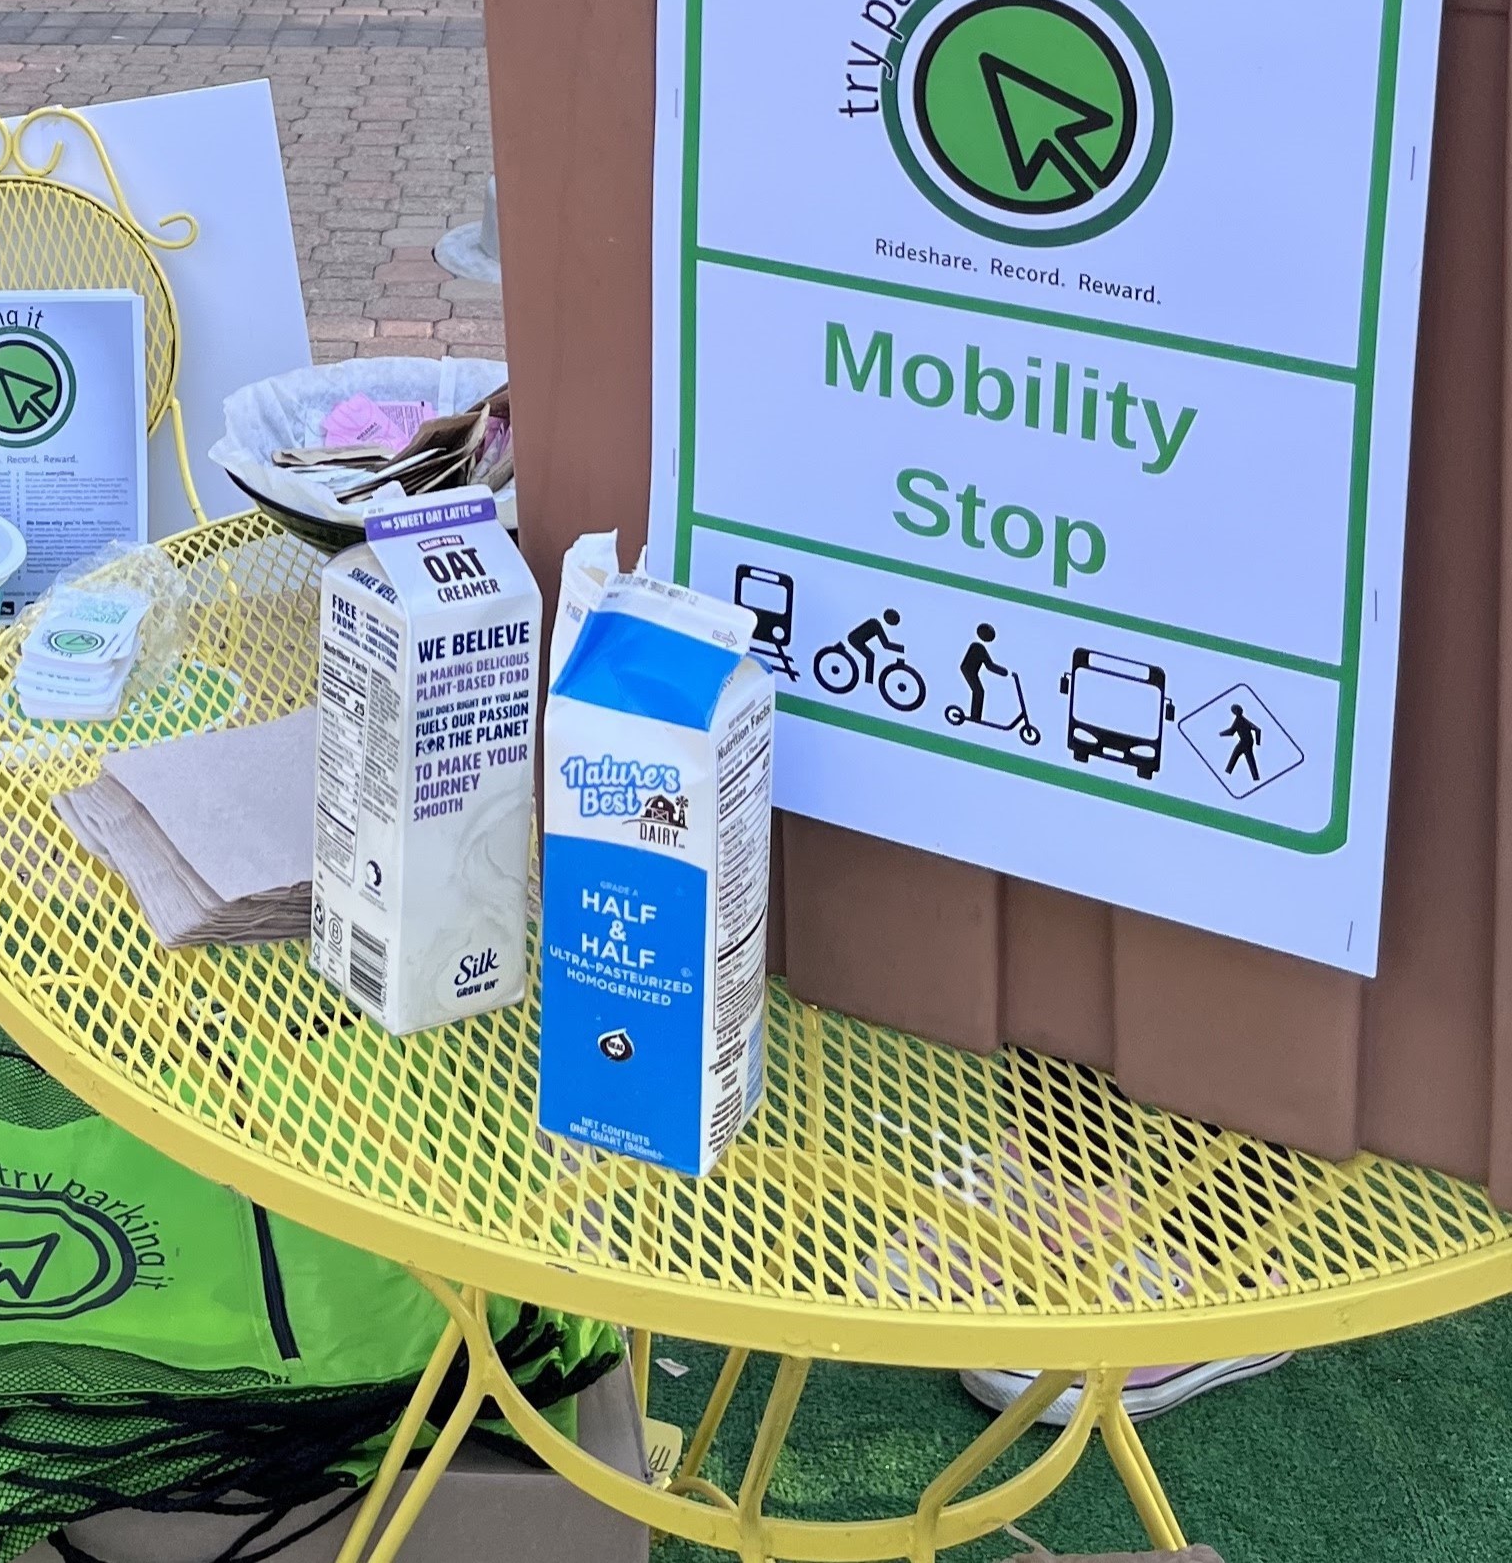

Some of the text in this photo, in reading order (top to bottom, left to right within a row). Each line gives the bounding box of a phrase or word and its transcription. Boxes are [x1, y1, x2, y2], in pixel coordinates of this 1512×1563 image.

[838, 40, 893, 118] try
[875, 238, 1162, 305] Rideshare. Record. Reward.
[27, 306, 44, 330] it
[825, 321, 1199, 475] Mobility
[392, 512, 425, 531] SWEET
[425, 509, 443, 524] OAT
[444, 505, 470, 522] LATTE
[892, 467, 1107, 589] Stop
[423, 547, 486, 584] OAT
[437, 578, 501, 603] CREAMER
[332, 593, 356, 621] FREE
[418, 621, 529, 664] WE BELIEVE
[417, 652, 529, 686] IN MAKING DELICIOUS
[417, 673, 495, 703] PLANT-BASED
[354, 699, 365, 717] 25
[416, 701, 528, 738] FUELS OUR PASSION
[417, 707, 433, 720] THAT
[436, 703, 454, 716] DOES
[457, 698, 479, 711] RIGHT
[495, 692, 510, 704] YOU
[513, 690, 529, 700] AND
[448, 729, 472, 749] THE
[477, 719, 528, 744] PLANET
[718, 724, 749, 762] Nutrition
[751, 704, 770, 730] Facts
[415, 744, 528, 783] TO MAKE YOUR
[561, 754, 680, 794] Nature's
[414, 773, 480, 804] JOURNEY
[580, 786, 642, 817] Best
[719, 785, 747, 815] Calories
[413, 797, 463, 822] SMOOTH
[640, 822, 679, 848] DAIRY
[599, 880, 629, 896] GRADE
[582, 888, 657, 925] HALF
[609, 919, 627, 941] &
[581, 932, 656, 969] HALF
[454, 948, 500, 986] Silk
[549, 944, 693, 994] ULTRA-PASTEURIZED
[457, 983, 482, 998] GROW
[567, 967, 671, 1006] HOMOGENIZED
[570, 1122, 589, 1136] ONE
[591, 1128, 621, 1147] QUART
[582, 1116, 650, 1147] NET CONTENTS
[60, 1178, 166, 1266] parking
[133, 1273, 174, 1290] it
